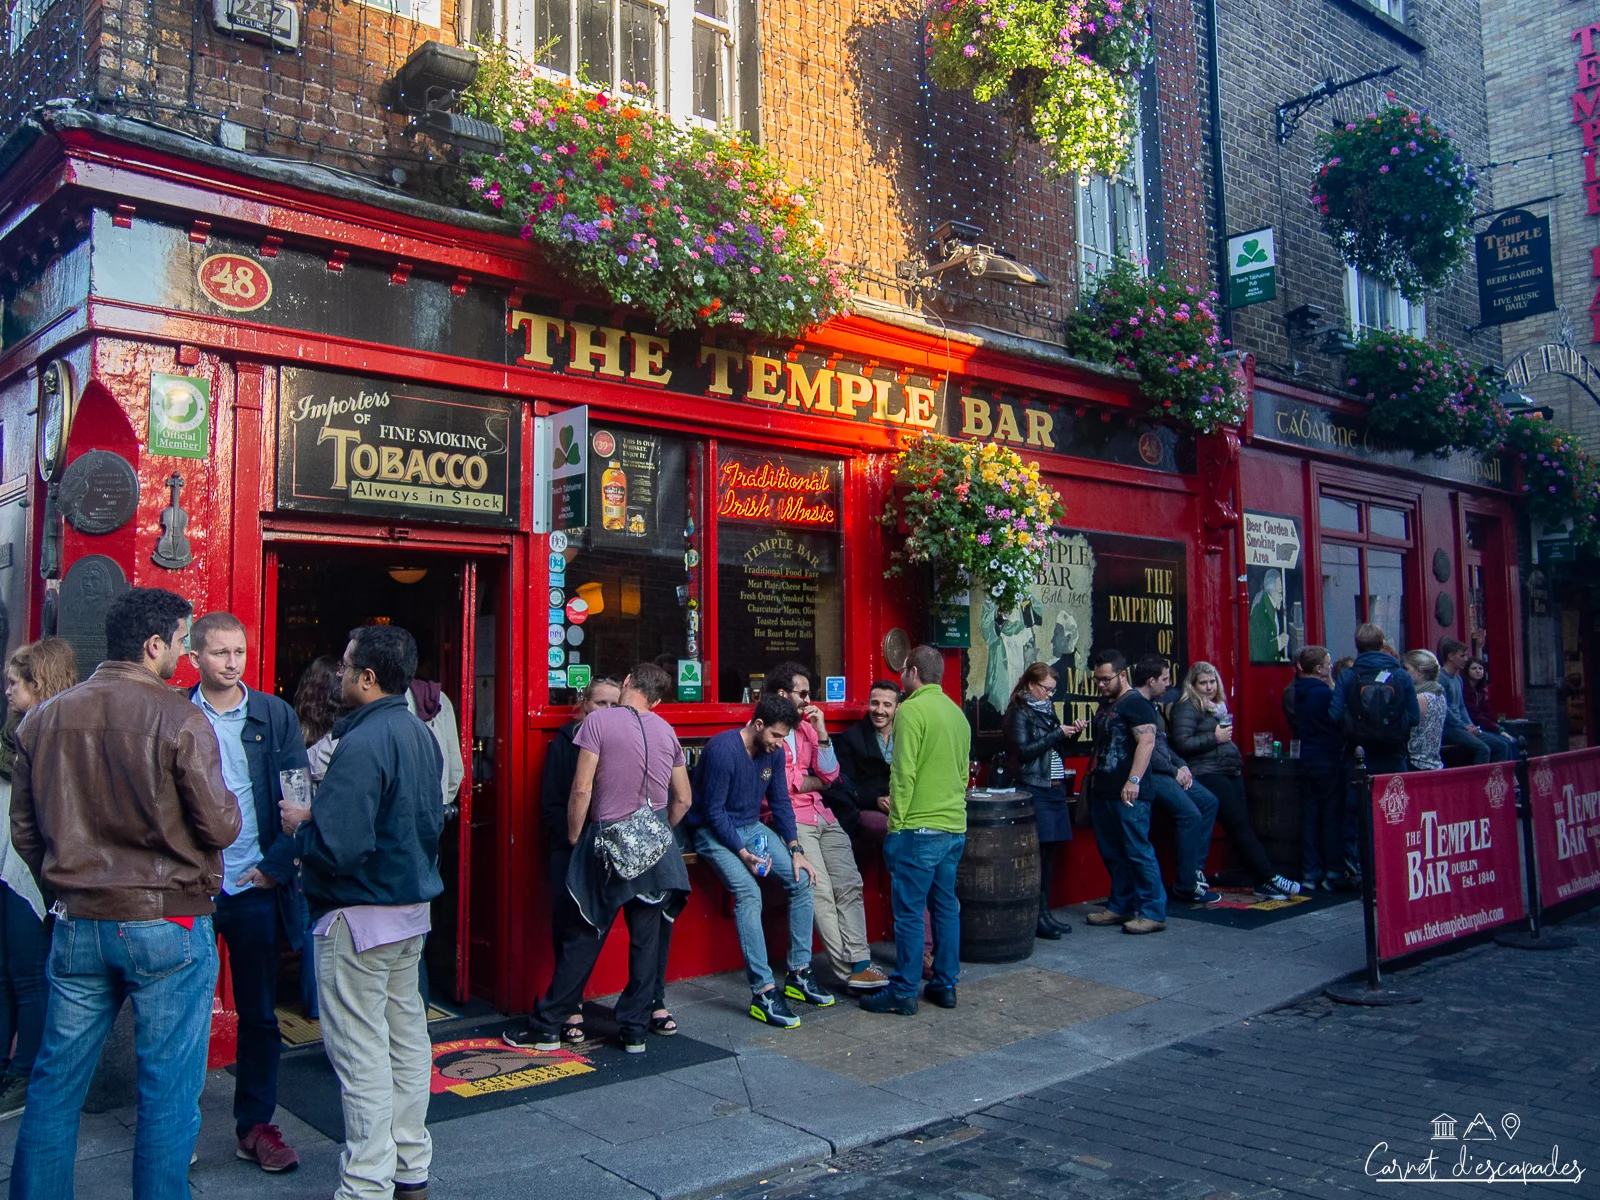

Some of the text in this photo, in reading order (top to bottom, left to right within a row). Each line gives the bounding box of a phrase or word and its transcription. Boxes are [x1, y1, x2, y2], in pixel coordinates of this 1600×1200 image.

[1501, 215, 1521, 227] THE
[1484, 226, 1543, 250] TEMPLE
[1497, 244, 1530, 262] BAR
[210, 261, 256, 299] 48
[1486, 266, 1543, 286] BEER GARDEN
[1493, 290, 1540, 307] LIVE MUSIC
[1505, 300, 1529, 312] DAILY
[1538, 344, 1595, 388] TEMPLE
[508, 310, 1055, 450] THE TEMPLE BAR
[290, 390, 390, 426] Importers
[354, 412, 371, 425] OF
[159, 438, 198, 450] Member
[162, 429, 196, 441] Official
[379, 424, 488, 450] FINE SMOKING
[317, 426, 488, 490] TOBACCO
[723, 462, 830, 491] Traditional
[354, 482, 500, 509] Always in Stock
[720, 489, 835, 523] Irish Music
[775, 529, 787, 537] The
[1245, 517, 1296, 538] Beer Garden &
[743, 538, 820, 569] TEMPLE BAR
[1246, 534, 1276, 553] Smoking
[1253, 550, 1270, 564] Area
[743, 564, 820, 579] Traditional Food Fare
[1037, 565, 1073, 590] BAR
[1144, 567, 1173, 595] THE
[740, 591, 756, 600] Fresh
[782, 593, 804, 604] Smoked
[747, 579, 763, 589] Meat
[781, 581, 801, 591] Cheese
[802, 582, 820, 592] Board
[756, 616, 812, 628] Toasted Sandwiches
[1109, 595, 1174, 625] EMPEROR
[754, 628, 814, 640] Hot Roast Beef Rolls
[1157, 629, 1174, 655] OF
[1562, 784, 1600, 826] TEMP
[1405, 811, 1492, 860] THE TEMPLE
[1555, 818, 1588, 861] BAR
[1407, 850, 1479, 901] BAR DUBLIN
[1462, 870, 1496, 889] Est. 1840
[1404, 907, 1505, 946] www.thetemplebarpub.com
